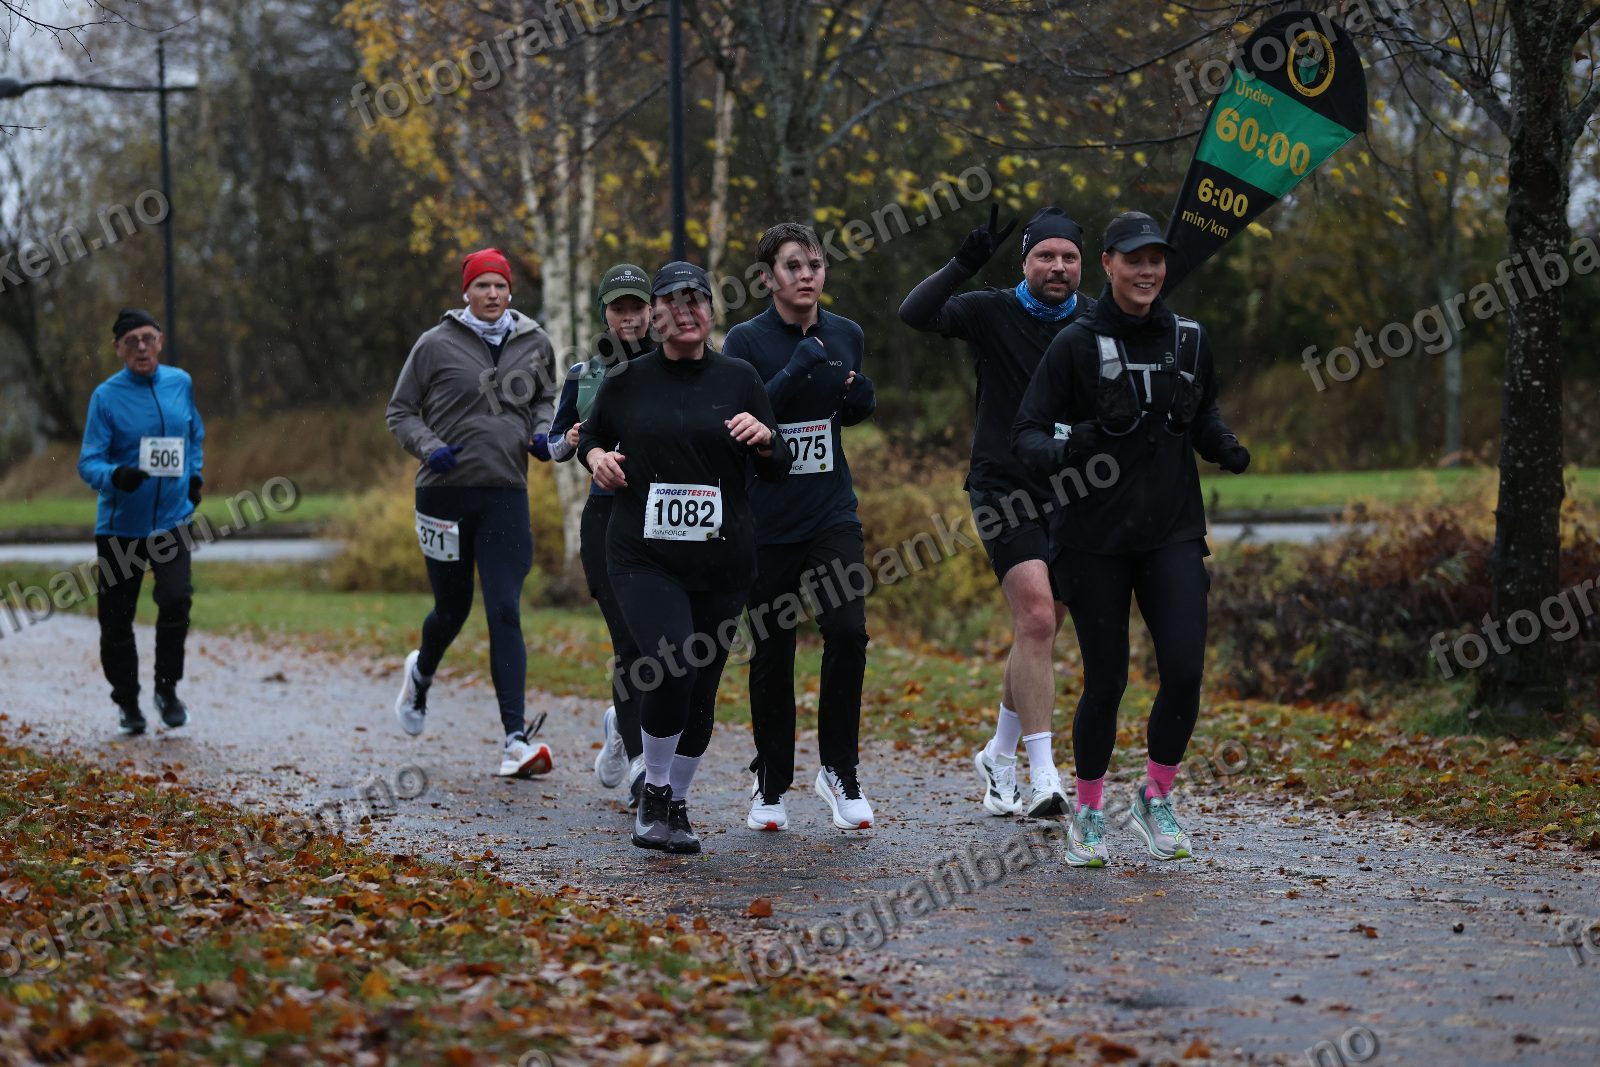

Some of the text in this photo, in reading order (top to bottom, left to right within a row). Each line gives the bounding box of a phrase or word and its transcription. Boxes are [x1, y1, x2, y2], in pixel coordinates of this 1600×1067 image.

[1235, 80, 1275, 107] Under
[1215, 106, 1311, 176] 60:00
[1197, 177, 1249, 218] 6:00
[1181, 209, 1230, 239] min/km
[150, 449, 180, 468] 506
[654, 498, 716, 528] 1082
[420, 525, 445, 551] 371
